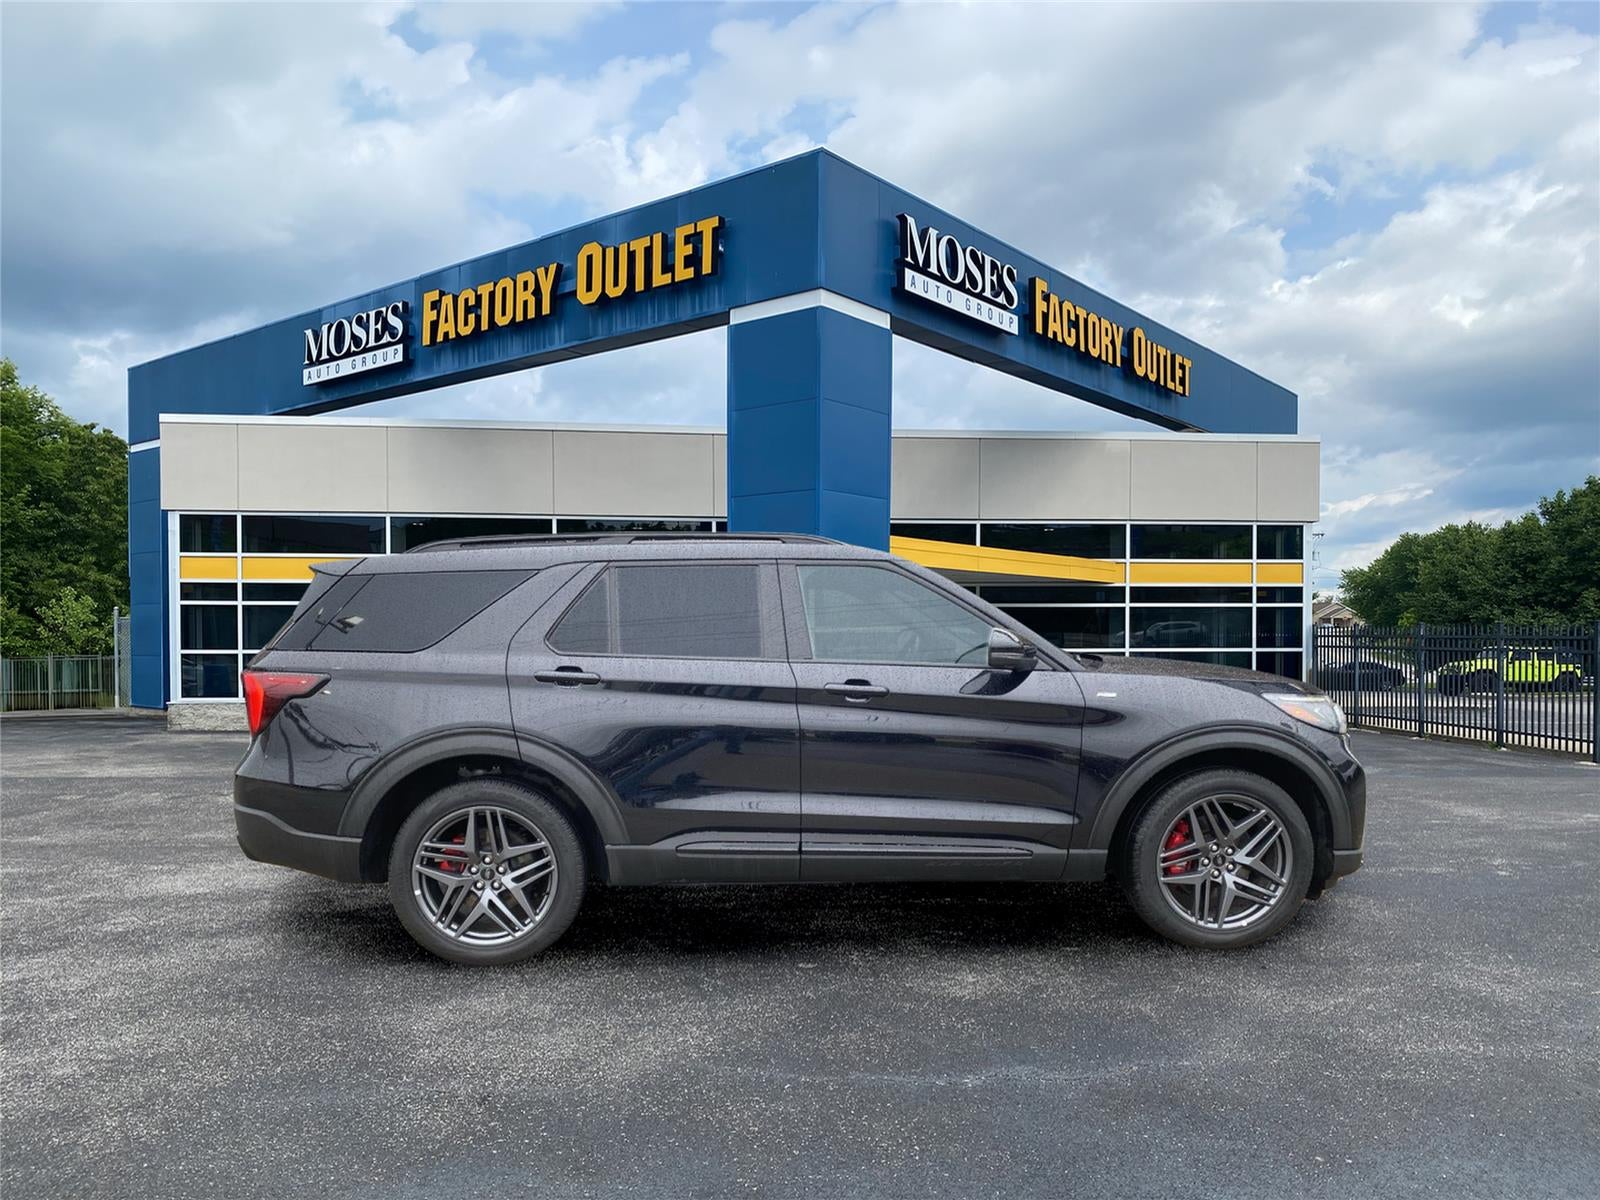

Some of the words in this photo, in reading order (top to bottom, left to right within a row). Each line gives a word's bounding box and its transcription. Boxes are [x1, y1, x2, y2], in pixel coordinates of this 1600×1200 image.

[422, 262, 560, 347] FACTORY
[577, 215, 720, 306] OUTLET
[904, 213, 1019, 310] MOSES
[910, 274, 953, 304] AUTO
[965, 299, 1015, 328] GROUP
[303, 301, 404, 365] MOSES
[307, 363, 340, 381] AUTO
[351, 348, 399, 370] GROUP
[1034, 276, 1124, 368] FACTORY
[1132, 326, 1192, 397] OUTLET
